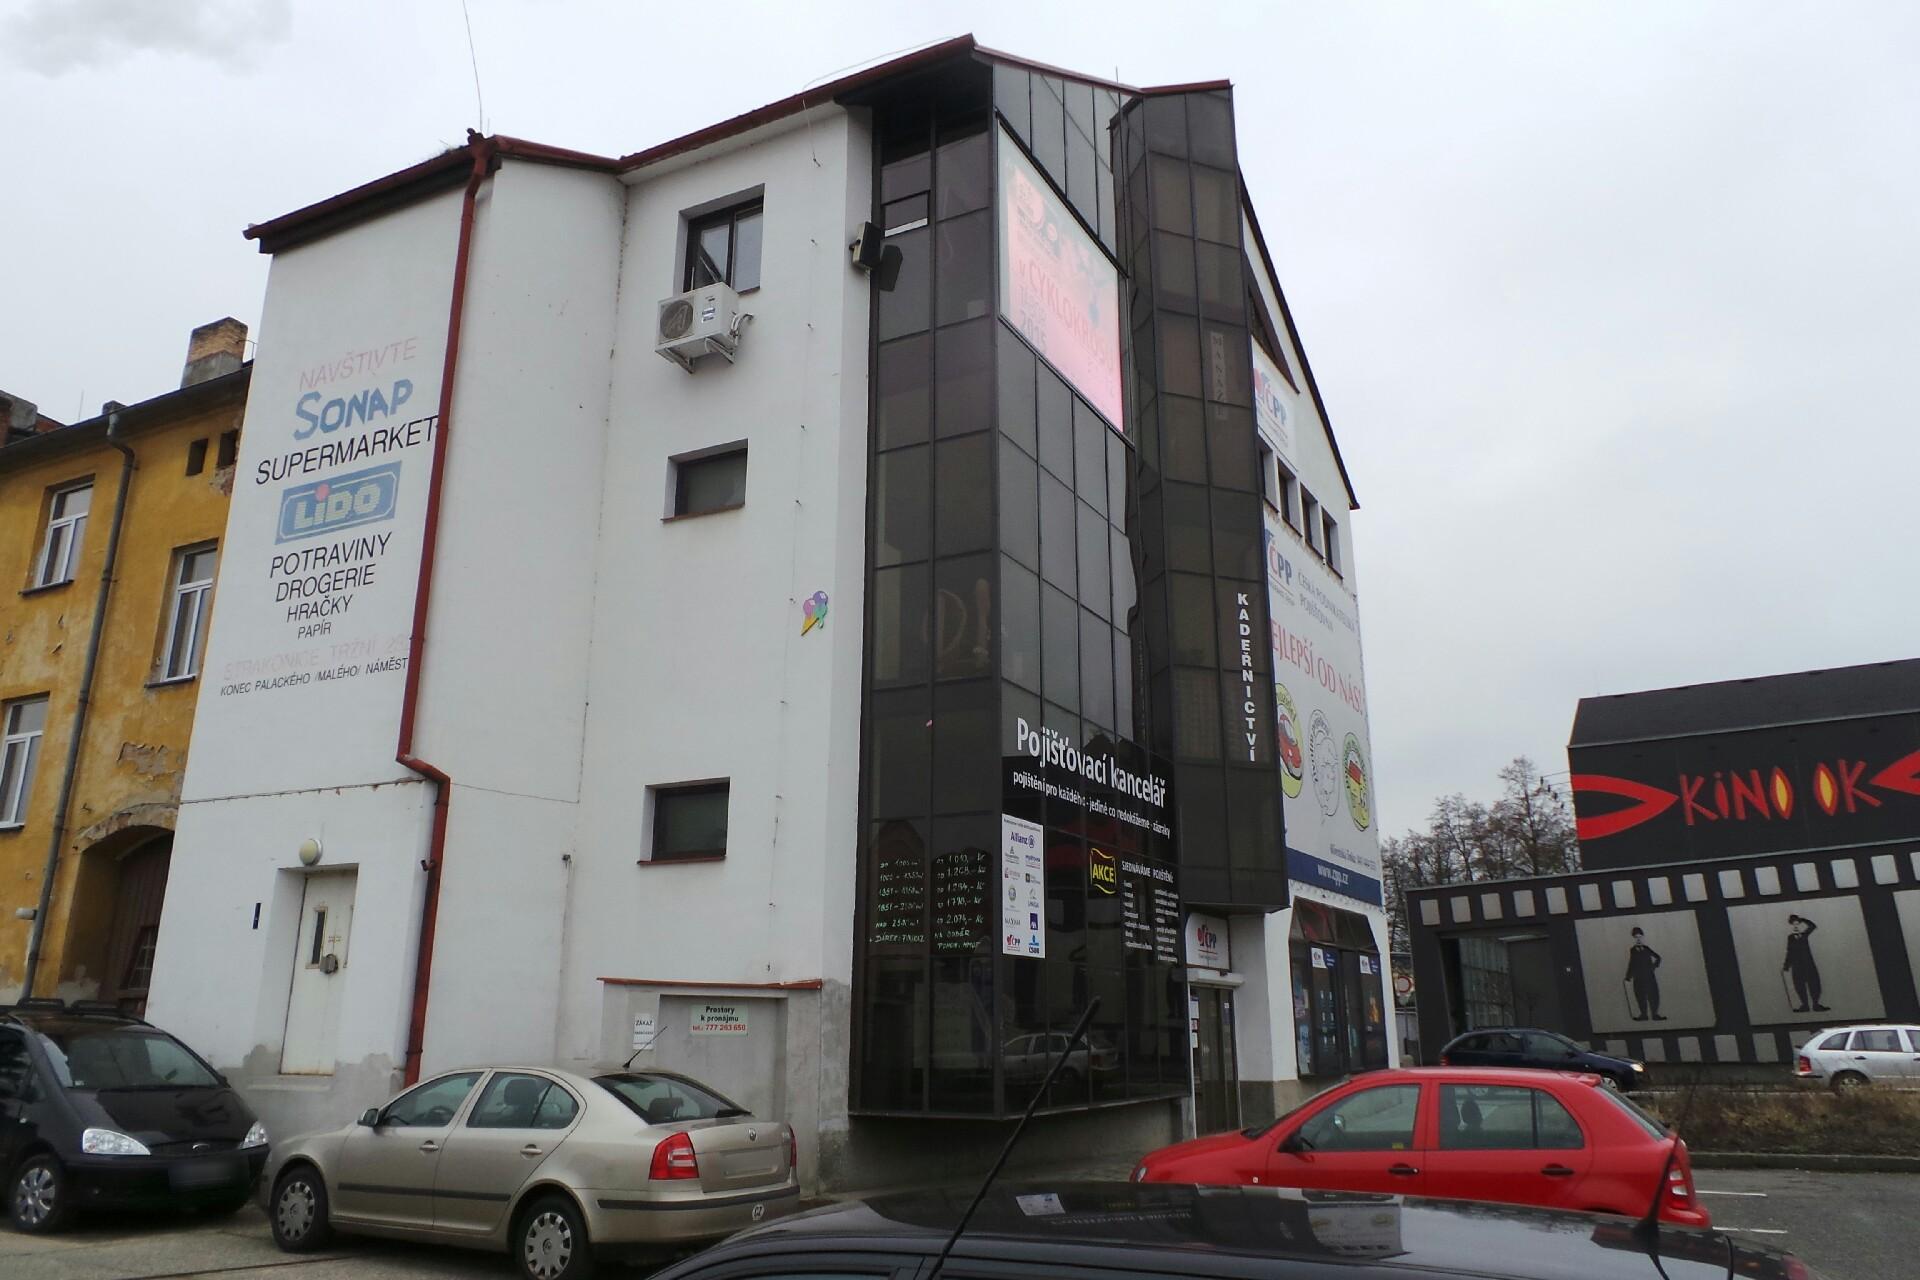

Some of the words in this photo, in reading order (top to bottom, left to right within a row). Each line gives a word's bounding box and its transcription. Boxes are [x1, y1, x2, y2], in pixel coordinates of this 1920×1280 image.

[300, 337, 417, 389] NAVŠTIVTE
[256, 414, 440, 485] SUPERMARKET
[270, 531, 392, 579] POTRAVINY
[276, 563, 376, 603] DROGERIE
[287, 594, 353, 623] HRAČKY
[298, 619, 332, 640] PAPÍR
[220, 682, 251, 697] KONEC
[255, 671, 310, 691] PALACKÉHO
[365, 657, 408, 675] NÁMĚST
[1237, 592, 1257, 762] KADEŘNICTVÍ
[1271, 619, 1315, 679] EJLEPŠÍ
[1317, 657, 1336, 693] OD
[1013, 770, 1045, 792] pojištění
[1045, 782, 1057, 797] pro
[1017, 717, 1107, 785] Pojišťovací
[1110, 756, 1166, 808] kancelář
[1813, 759, 1883, 816] OK
[1092, 863, 1115, 883] AKCE
[706, 1005, 735, 1015] Prostory
